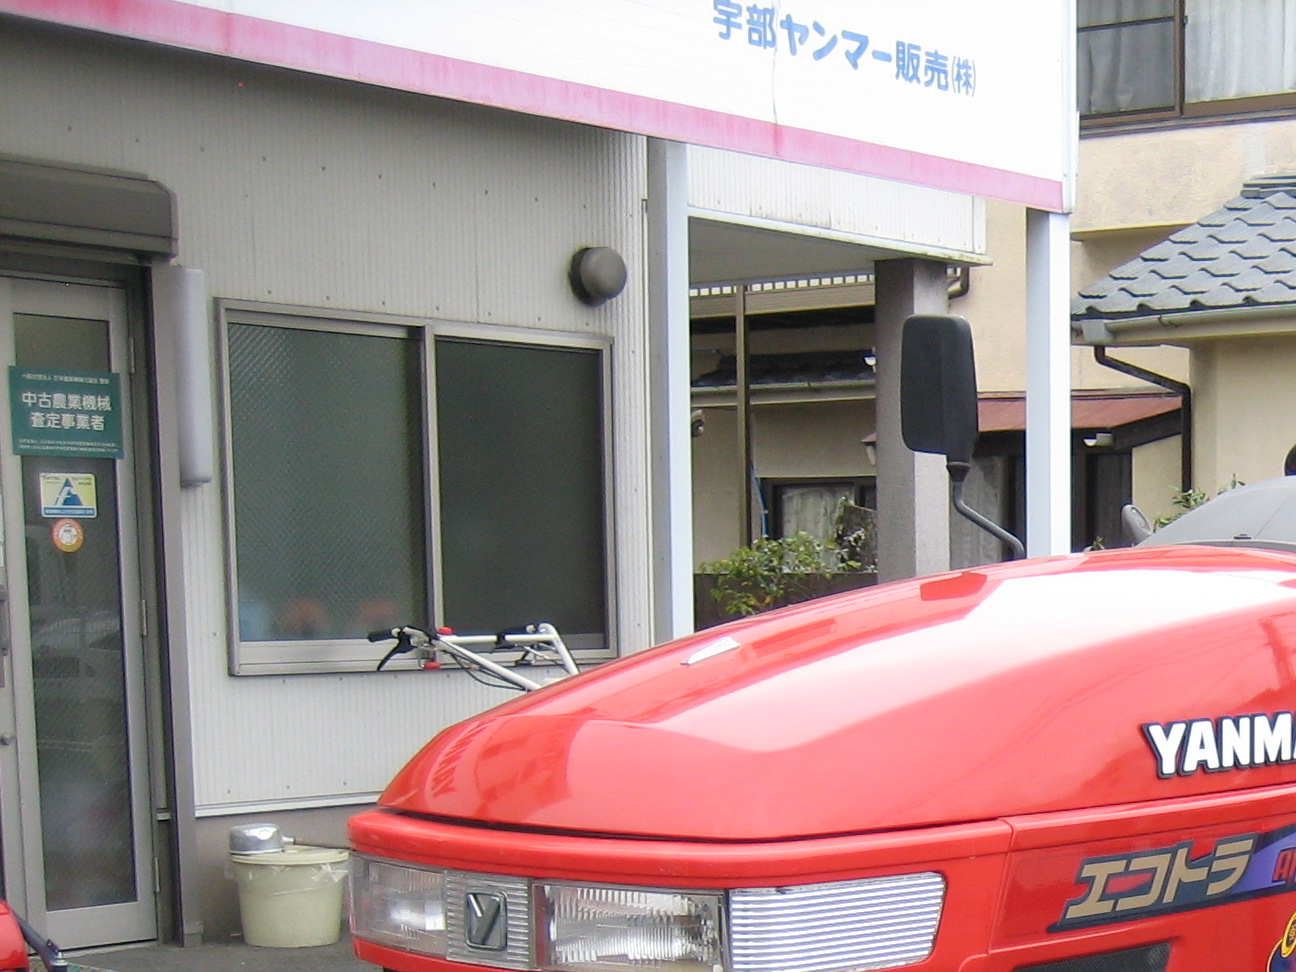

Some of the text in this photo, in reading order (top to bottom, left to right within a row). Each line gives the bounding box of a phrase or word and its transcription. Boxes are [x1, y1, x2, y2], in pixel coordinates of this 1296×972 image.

[30, 411, 105, 431] 査定事業者
[1065, 838, 1254, 920] エコトラ
